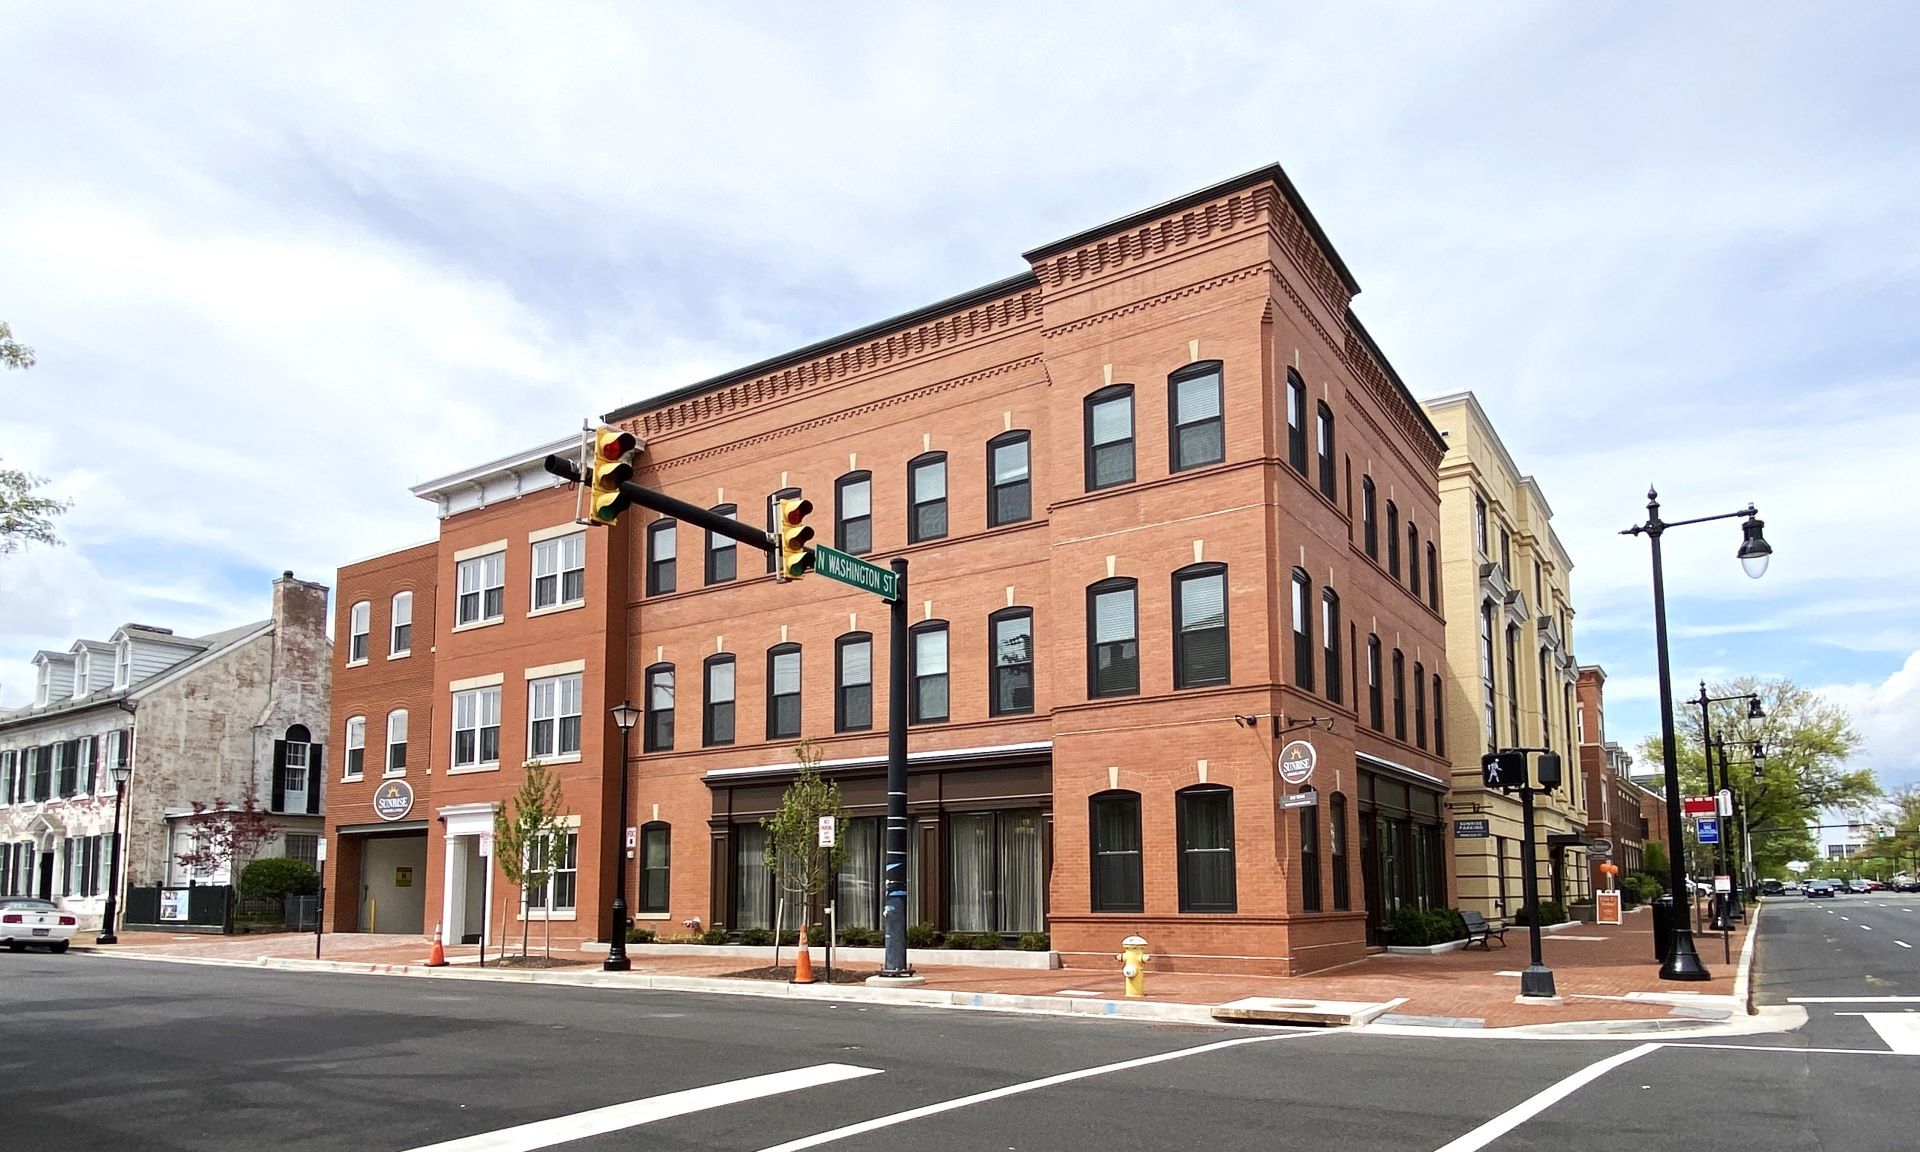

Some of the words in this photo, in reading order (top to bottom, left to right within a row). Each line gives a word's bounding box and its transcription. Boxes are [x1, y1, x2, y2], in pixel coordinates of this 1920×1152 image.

[817, 550, 825, 570] N
[828, 554, 880, 589] WASHINGTON
[883, 574, 893, 593] ST
[1283, 757, 1310, 772] SUNRISE
[379, 797, 408, 808] SUNRISE
